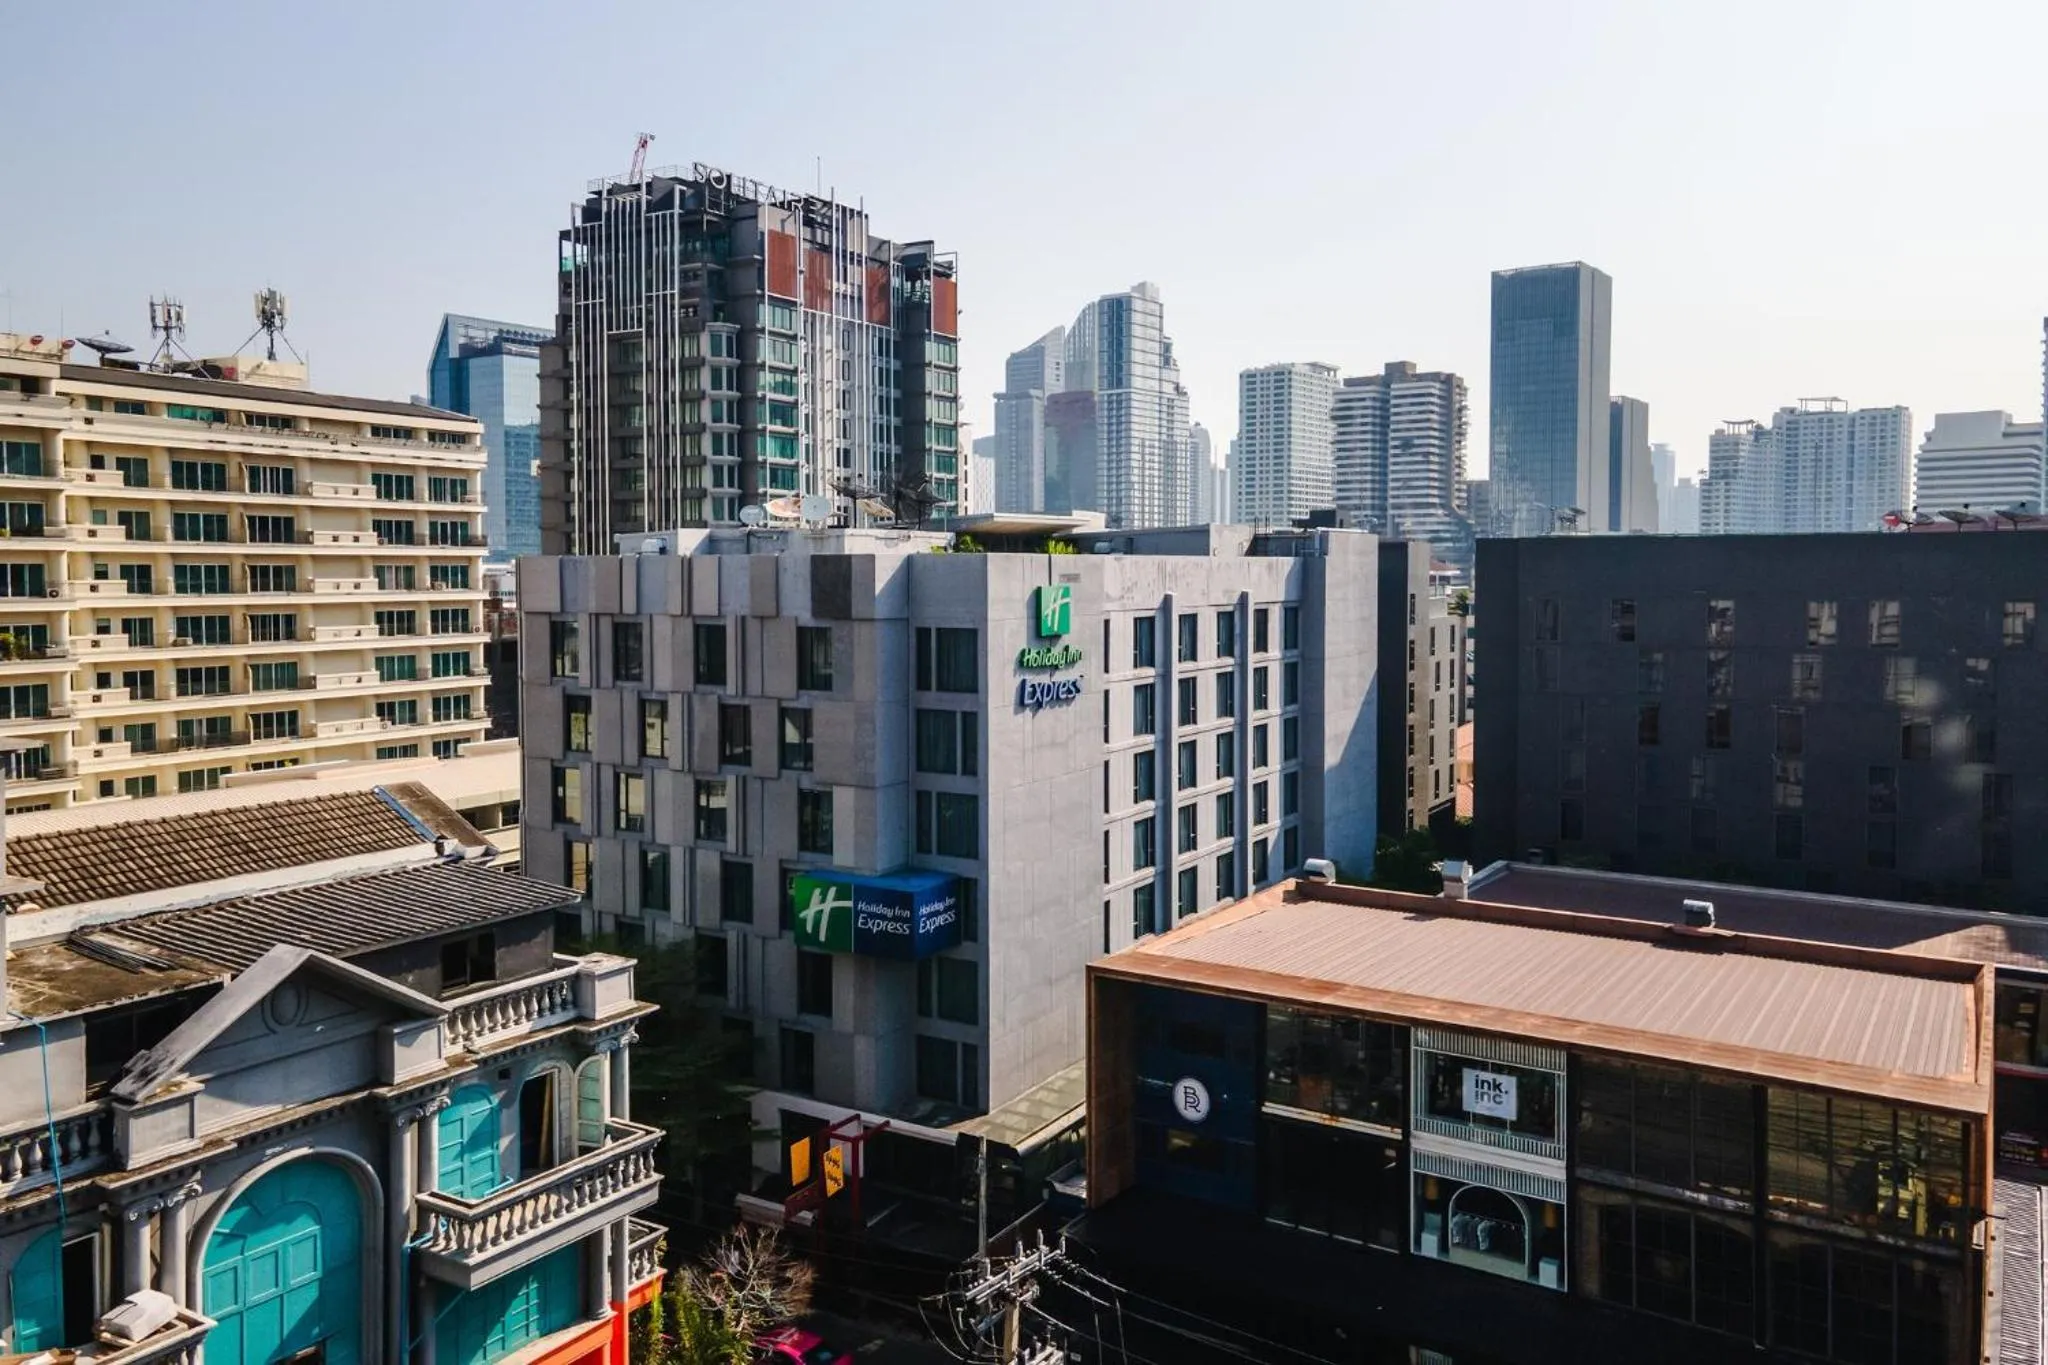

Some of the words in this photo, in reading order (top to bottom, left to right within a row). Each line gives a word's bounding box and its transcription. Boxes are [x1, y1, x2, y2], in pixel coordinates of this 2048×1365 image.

[1023, 648, 1066, 668] Holiday
[858, 900, 893, 918] Holiday
[894, 906, 911, 918] Inn
[919, 901, 945, 916] Holiday
[858, 914, 912, 935] Express
[919, 910, 955, 933] Express
[1475, 1074, 1508, 1094] ink.
